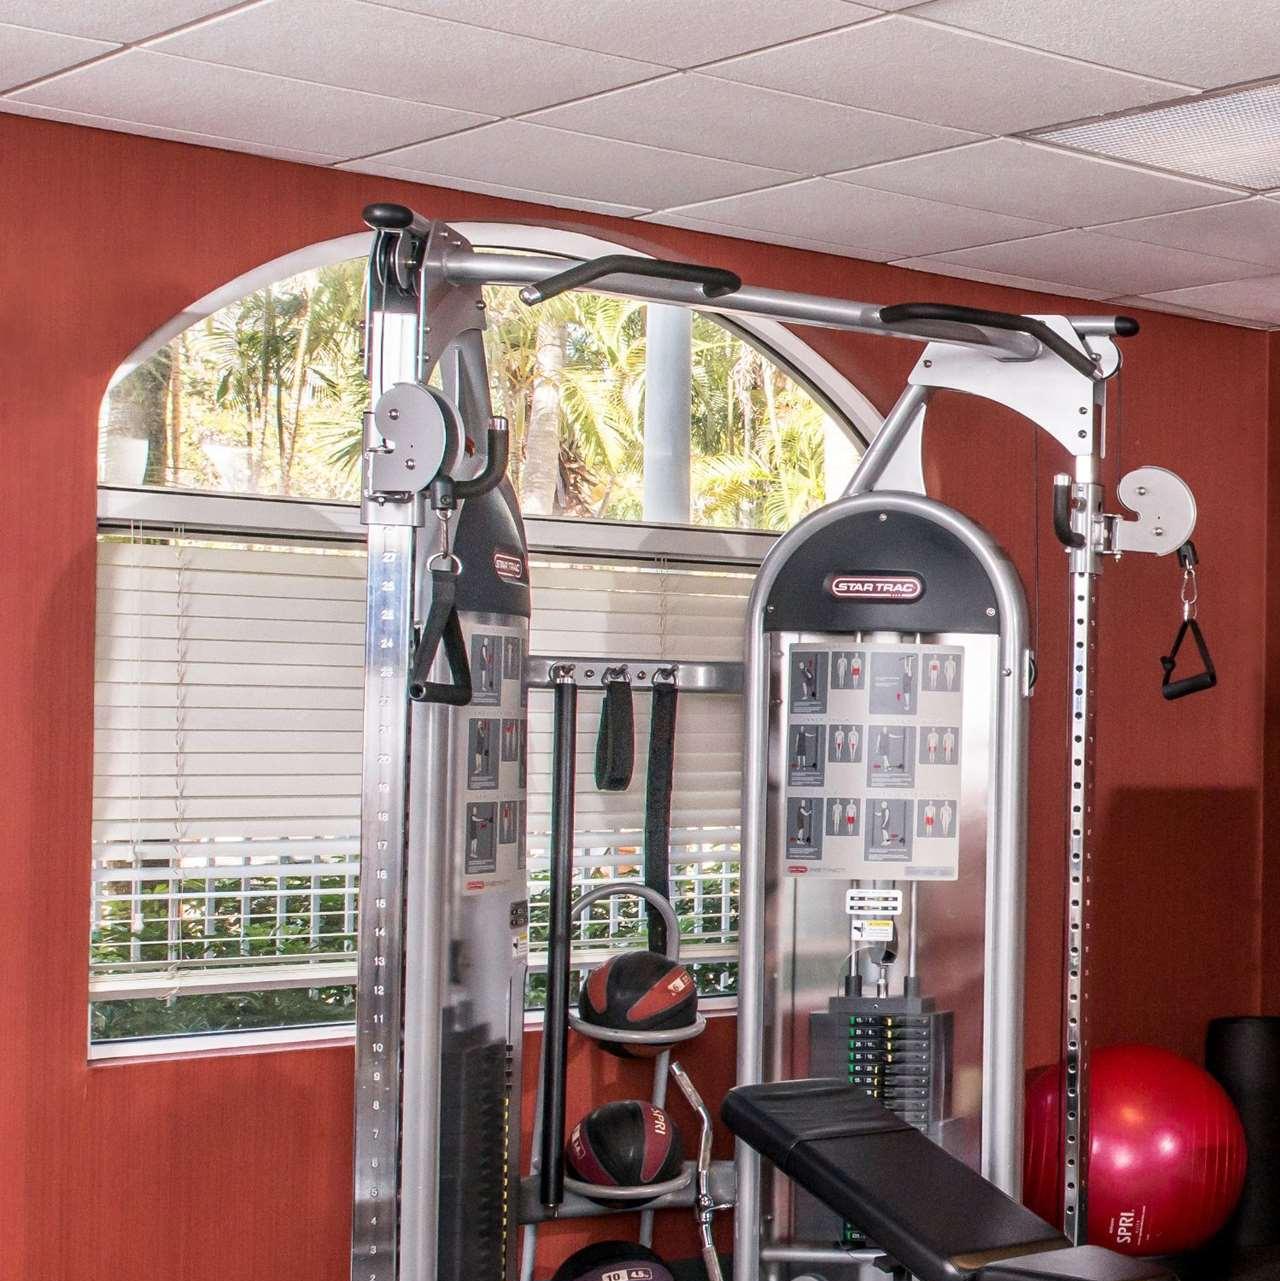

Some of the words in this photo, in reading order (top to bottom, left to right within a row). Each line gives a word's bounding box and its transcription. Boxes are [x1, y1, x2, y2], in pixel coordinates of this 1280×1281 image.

[837, 583, 873, 591] STAR
[876, 583, 913, 592] TRAC
[374, 927, 385, 937] 14
[374, 956, 385, 966] 13
[373, 986, 384, 995] 12
[373, 1015, 384, 1023] 11
[372, 1043, 383, 1052] 10
[373, 1072, 380, 1081] 9
[372, 1100, 380, 1110] 8
[372, 1129, 379, 1138] 7
[371, 1216, 377, 1226] 4
[1116, 1211, 1135, 1244] SPRI
[370, 1246, 377, 1254] 3
